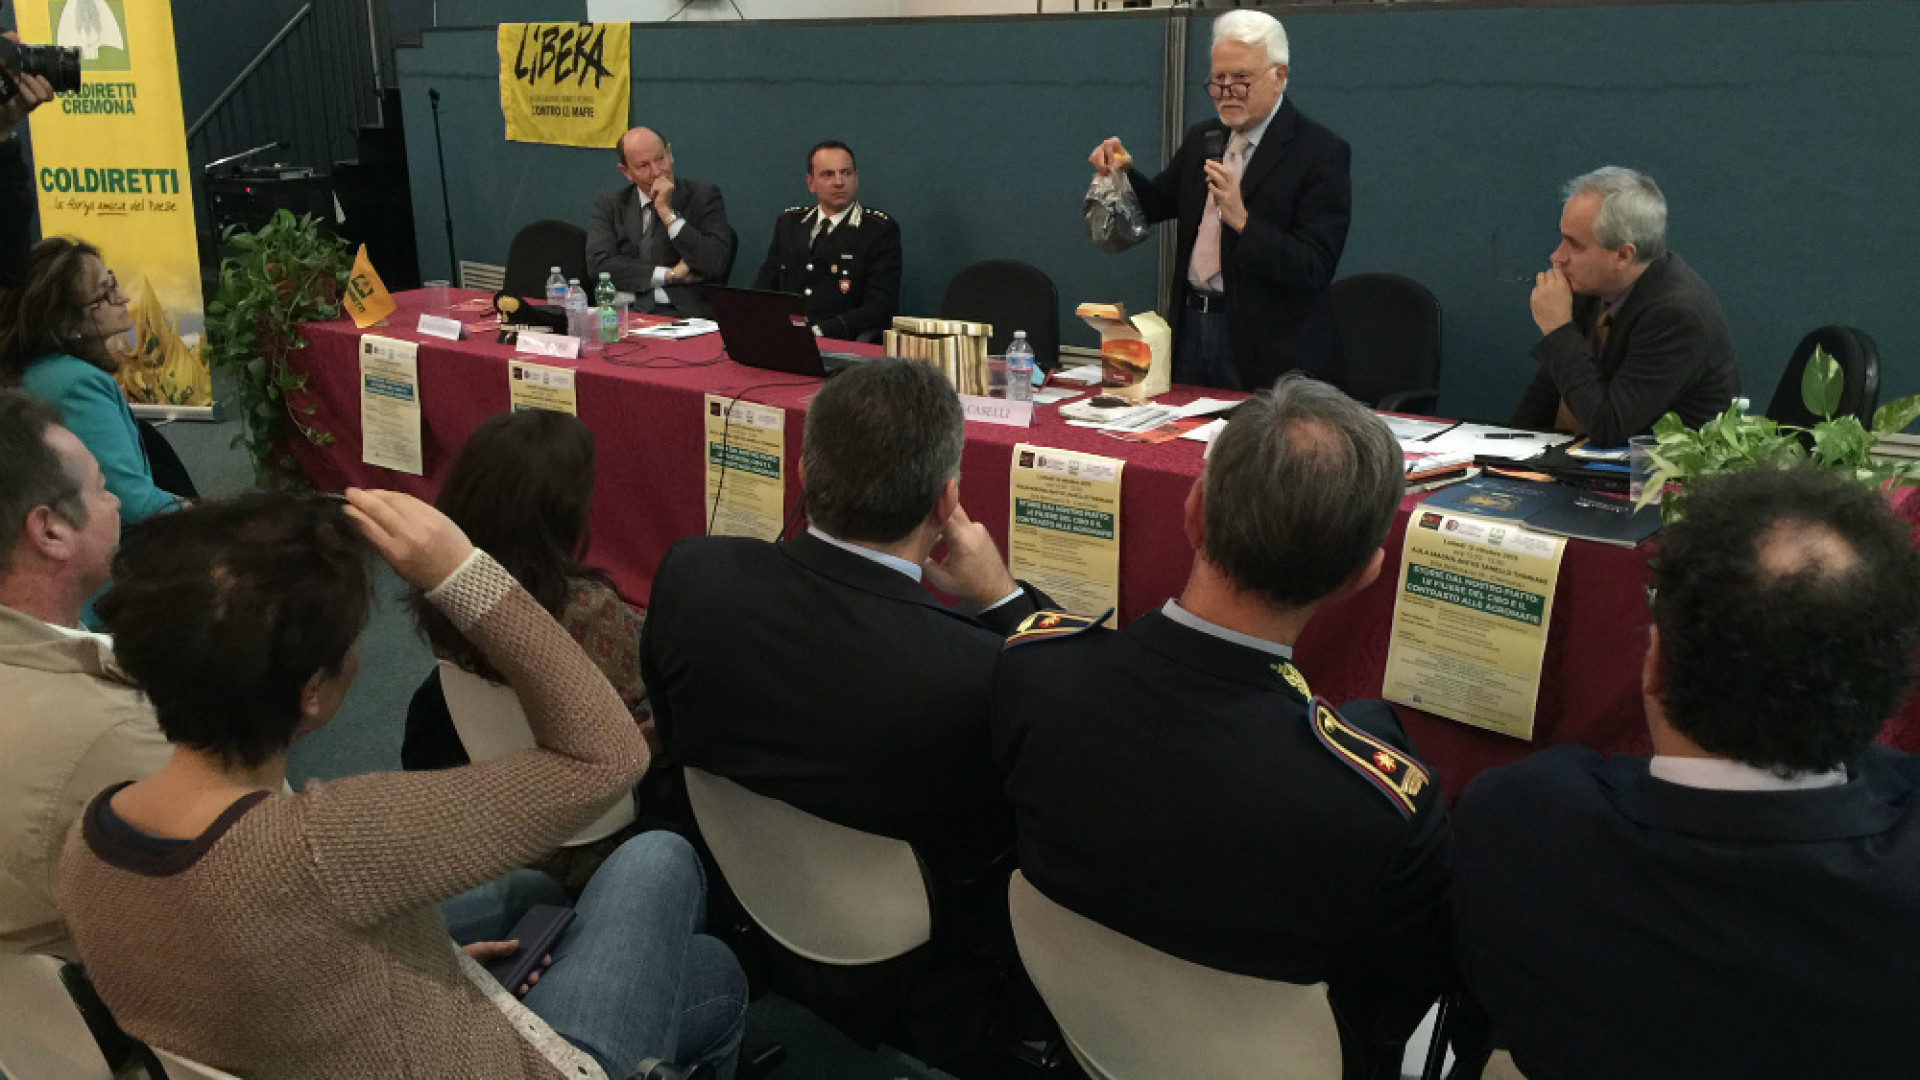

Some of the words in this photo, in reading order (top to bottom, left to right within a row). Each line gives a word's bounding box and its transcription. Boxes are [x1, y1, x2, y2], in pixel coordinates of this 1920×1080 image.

[62, 99, 137, 115] CREMONA
[572, 106, 594, 118] MAFIE
[40, 166, 180, 195] COLDIRETTI
[131, 197, 145, 212] del
[966, 404, 1011, 419] CASELLI
[1464, 577, 1502, 593] NOSTRO
[1406, 582, 1460, 603] CONTRASTO
[1460, 597, 1483, 610] ALLE
[1485, 602, 1540, 625] AGROMAFIE
[1468, 586, 1485, 600] DEL
[1487, 593, 1510, 606] CIBO
[1518, 601, 1527, 611] IL
